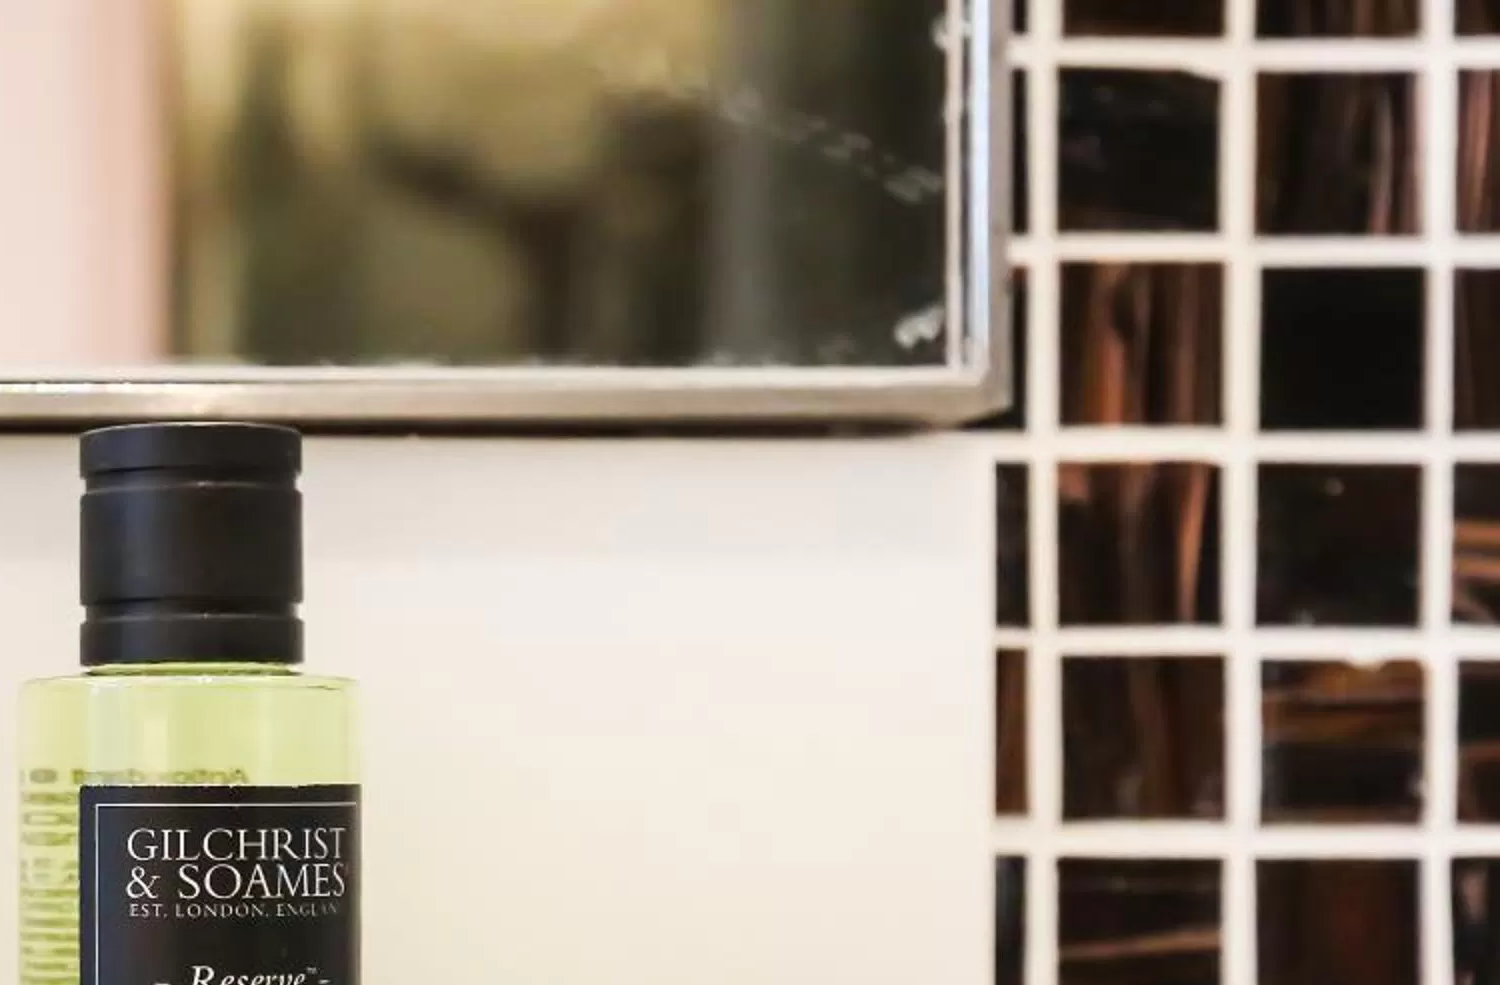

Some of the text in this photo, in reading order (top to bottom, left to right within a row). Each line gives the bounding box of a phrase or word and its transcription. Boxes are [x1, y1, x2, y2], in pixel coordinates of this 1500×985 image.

[127, 827, 347, 860] GILCHRIST
[126, 863, 346, 899] & SOAMES
